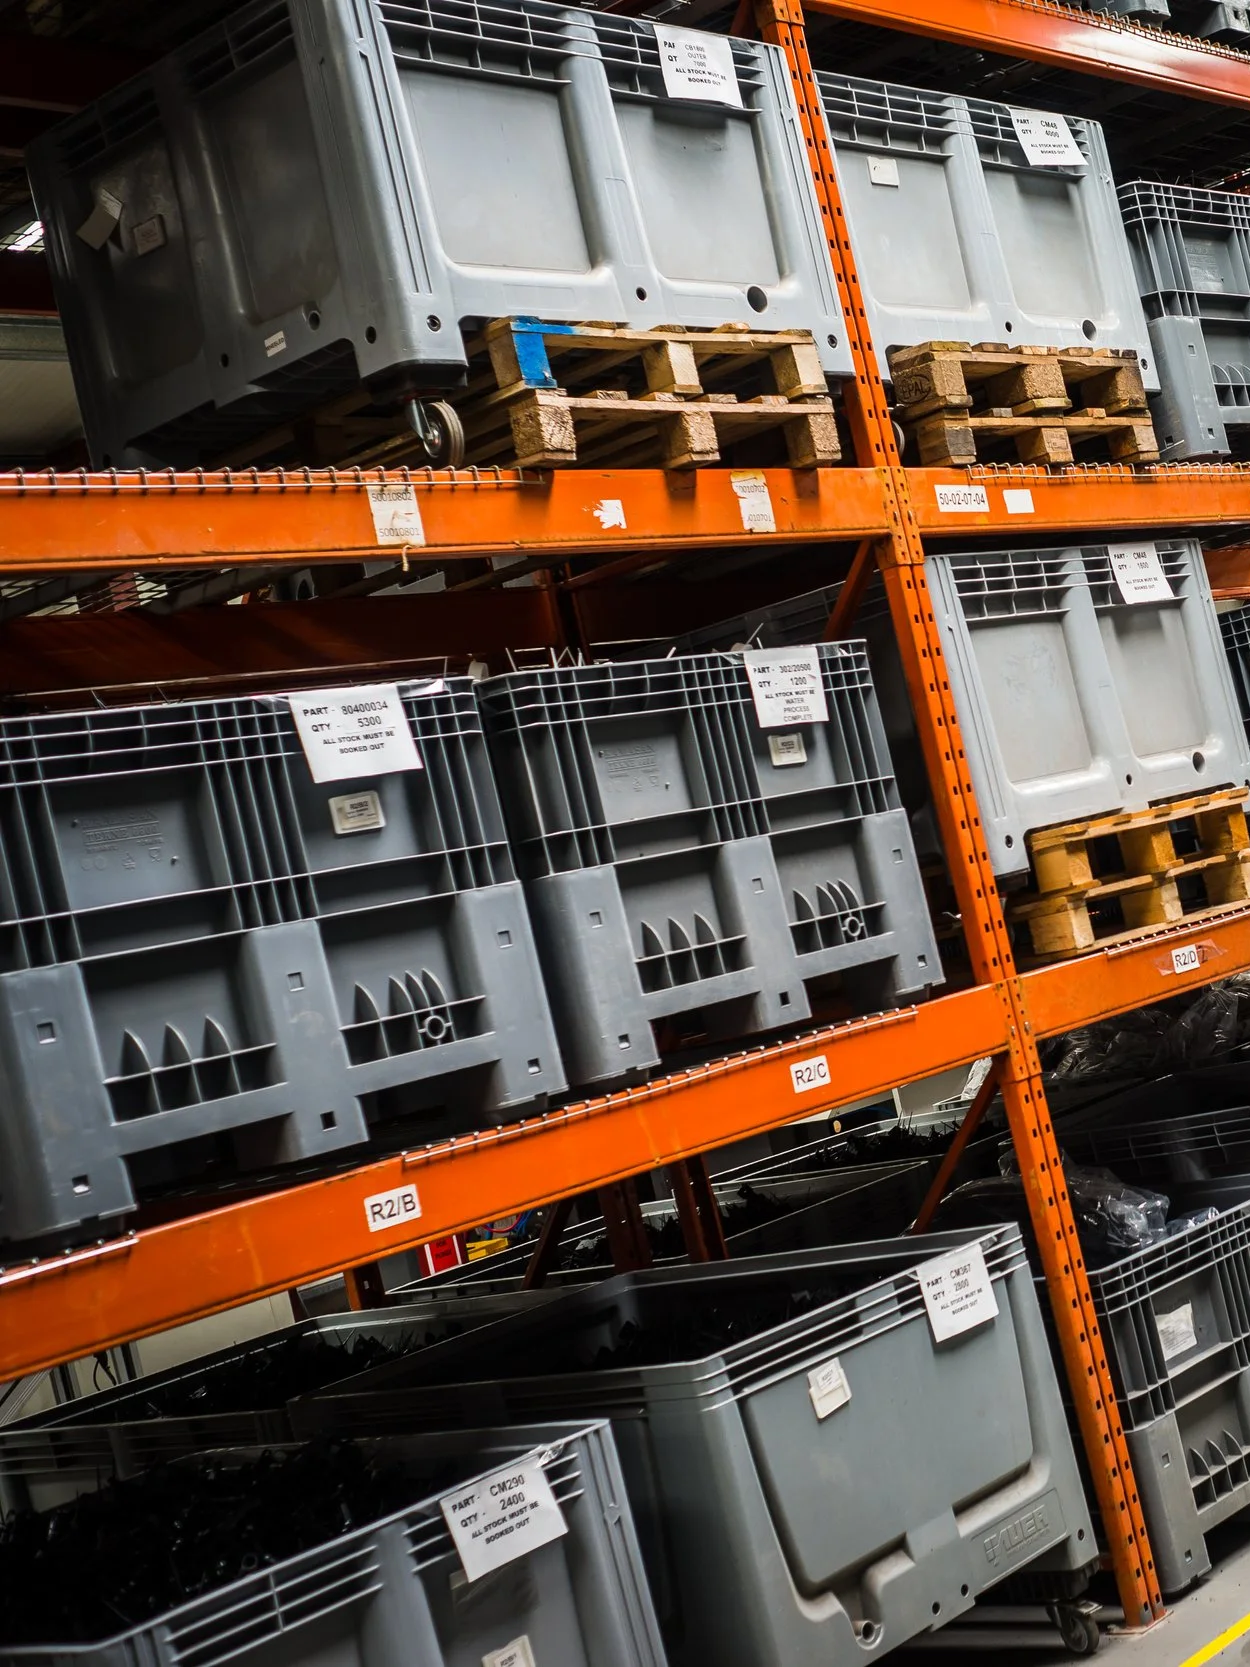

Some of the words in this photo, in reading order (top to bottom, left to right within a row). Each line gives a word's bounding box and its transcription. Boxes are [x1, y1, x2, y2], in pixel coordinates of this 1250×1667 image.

[371, 492, 412, 502] 50010802
[940, 492, 985, 505] 50-02-07-04
[379, 527, 420, 537] 50010801
[790, 677, 807, 686] 1200
[302, 706, 328, 717] PART
[341, 701, 388, 715] 80400034
[311, 723, 331, 733] QTY
[358, 716, 382, 728] 5300
[784, 714, 813, 722] COMPLETE
[339, 735, 361, 744] STOCK
[363, 732, 383, 740] MUST
[340, 746, 368, 754] BOOKED
[370, 743, 385, 751] OUT
[1175, 950, 1196, 967] R2/D
[795, 1062, 827, 1086] R2/C
[370, 1193, 416, 1223] R2/B
[926, 1277, 942, 1288] PART
[933, 1291, 945, 1300] QTY
[451, 1494, 476, 1513] PART
[489, 1474, 525, 1497] CM290
[460, 1512, 478, 1528] QTY
[500, 1492, 525, 1510] 2400
[472, 1531, 482, 1539] ALL
[484, 1517, 508, 1532] STOCK
[508, 1506, 528, 1519] MUST
[529, 1501, 540, 1510] BE
[485, 1526, 515, 1545] BOOKED
[516, 1518, 530, 1530] OUT
